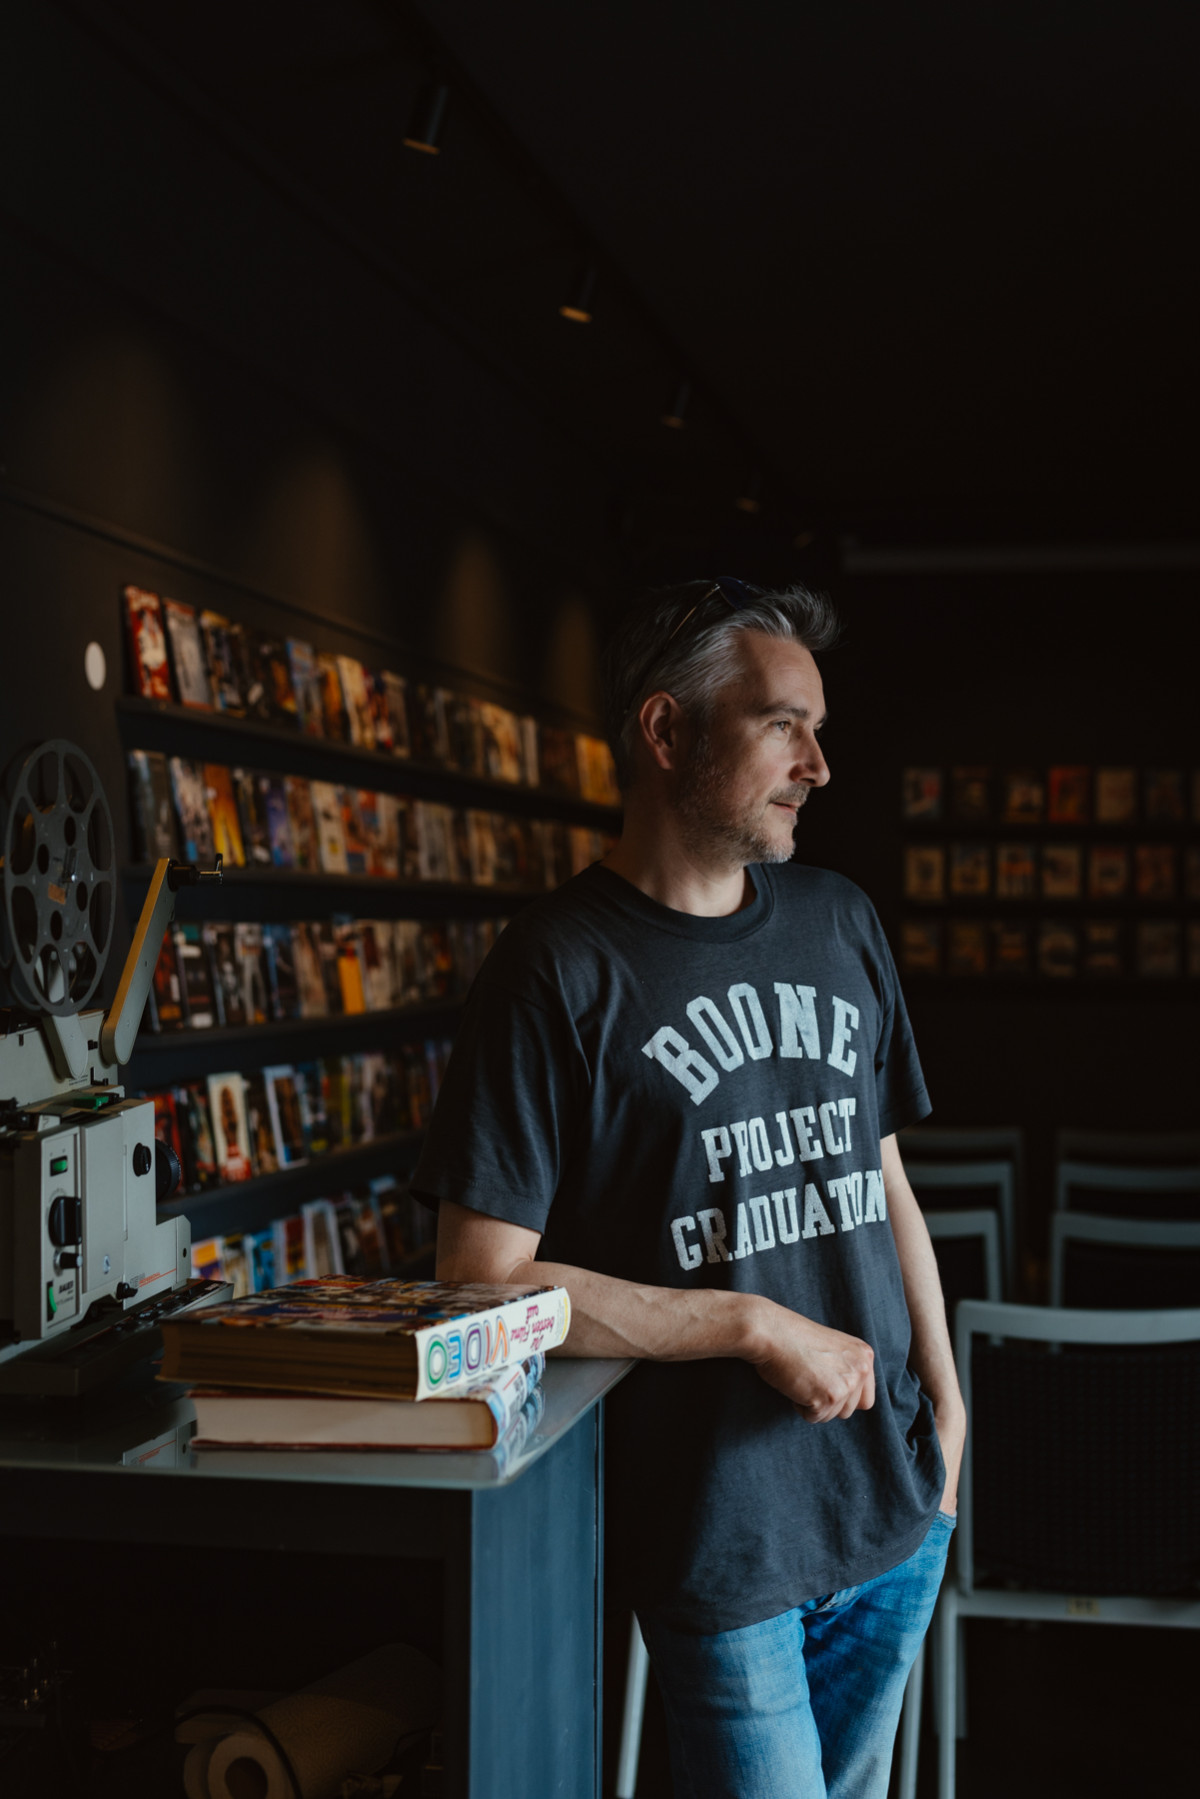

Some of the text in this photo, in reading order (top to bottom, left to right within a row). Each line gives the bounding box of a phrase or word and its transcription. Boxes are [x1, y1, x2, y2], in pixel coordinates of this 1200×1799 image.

[641, 982, 859, 1106] BOONE
[701, 1098, 856, 1183] PROJECT
[670, 1170, 887, 1271] GRADUATON
[426, 1316, 510, 1391] VIDEO
